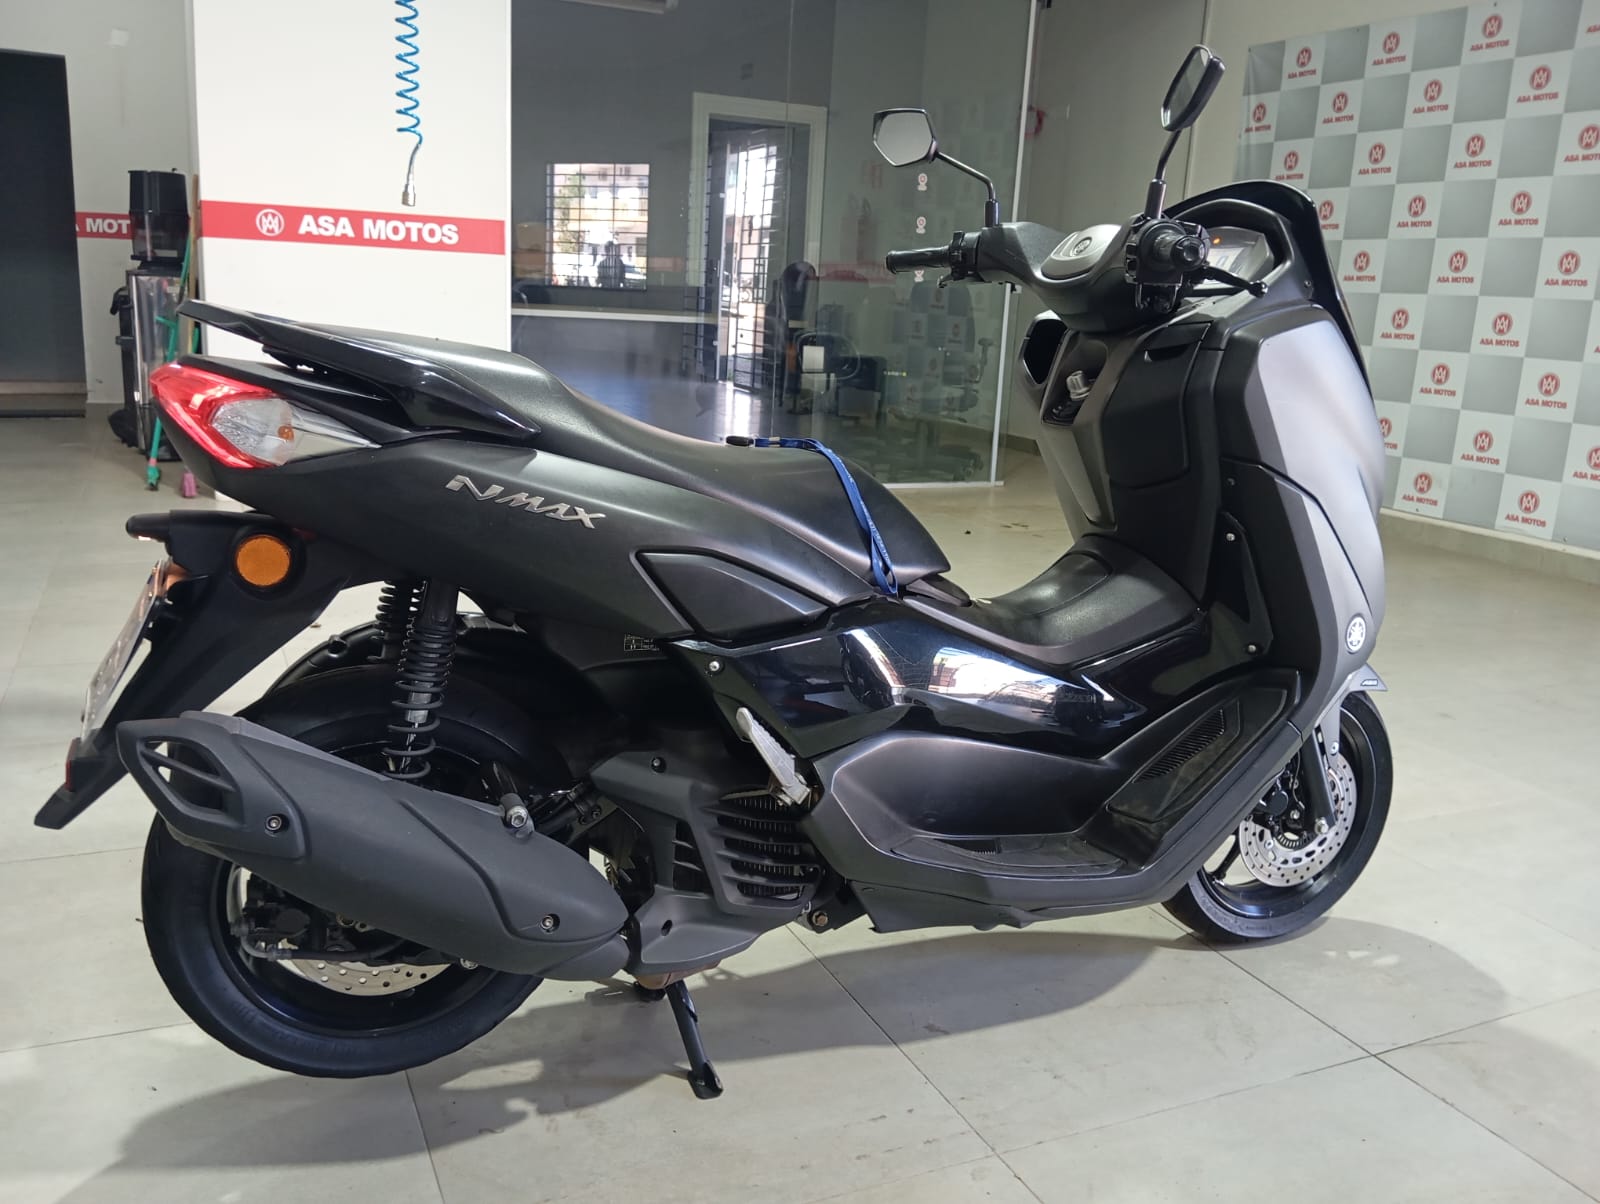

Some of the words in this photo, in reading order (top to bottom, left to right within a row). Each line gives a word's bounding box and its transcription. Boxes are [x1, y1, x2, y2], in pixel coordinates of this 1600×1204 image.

[1517, 95, 1531, 103] ASA
[1532, 92, 1559, 101] MOTOS
[1564, 154, 1579, 162] ASA
[86, 217, 131, 234] MOT
[1498, 218, 1512, 226] ASA
[1514, 217, 1539, 225] MOTOS
[297, 214, 355, 238] ASA
[362, 218, 459, 245] MOTOS
[1437, 275, 1449, 283] ASA
[1450, 276, 1474, 284] MOTOS
[1545, 278, 1559, 286] ASA
[1561, 279, 1588, 287] MOTOS
[1479, 338, 1493, 346] ASA
[1495, 339, 1520, 348] MOTOS
[1525, 398, 1540, 406] ASA
[1542, 399, 1568, 409] MOTOS
[1461, 453, 1474, 461] ASA
[1475, 456, 1500, 465] MOTOS
[1573, 471, 1588, 480] ASA
[446, 475, 606, 529] NMAX
[1402, 494, 1415, 502] ASA
[1416, 497, 1438, 507] MOTOS
[1505, 514, 1519, 522] ASA
[1521, 517, 1547, 527] MOTOS
